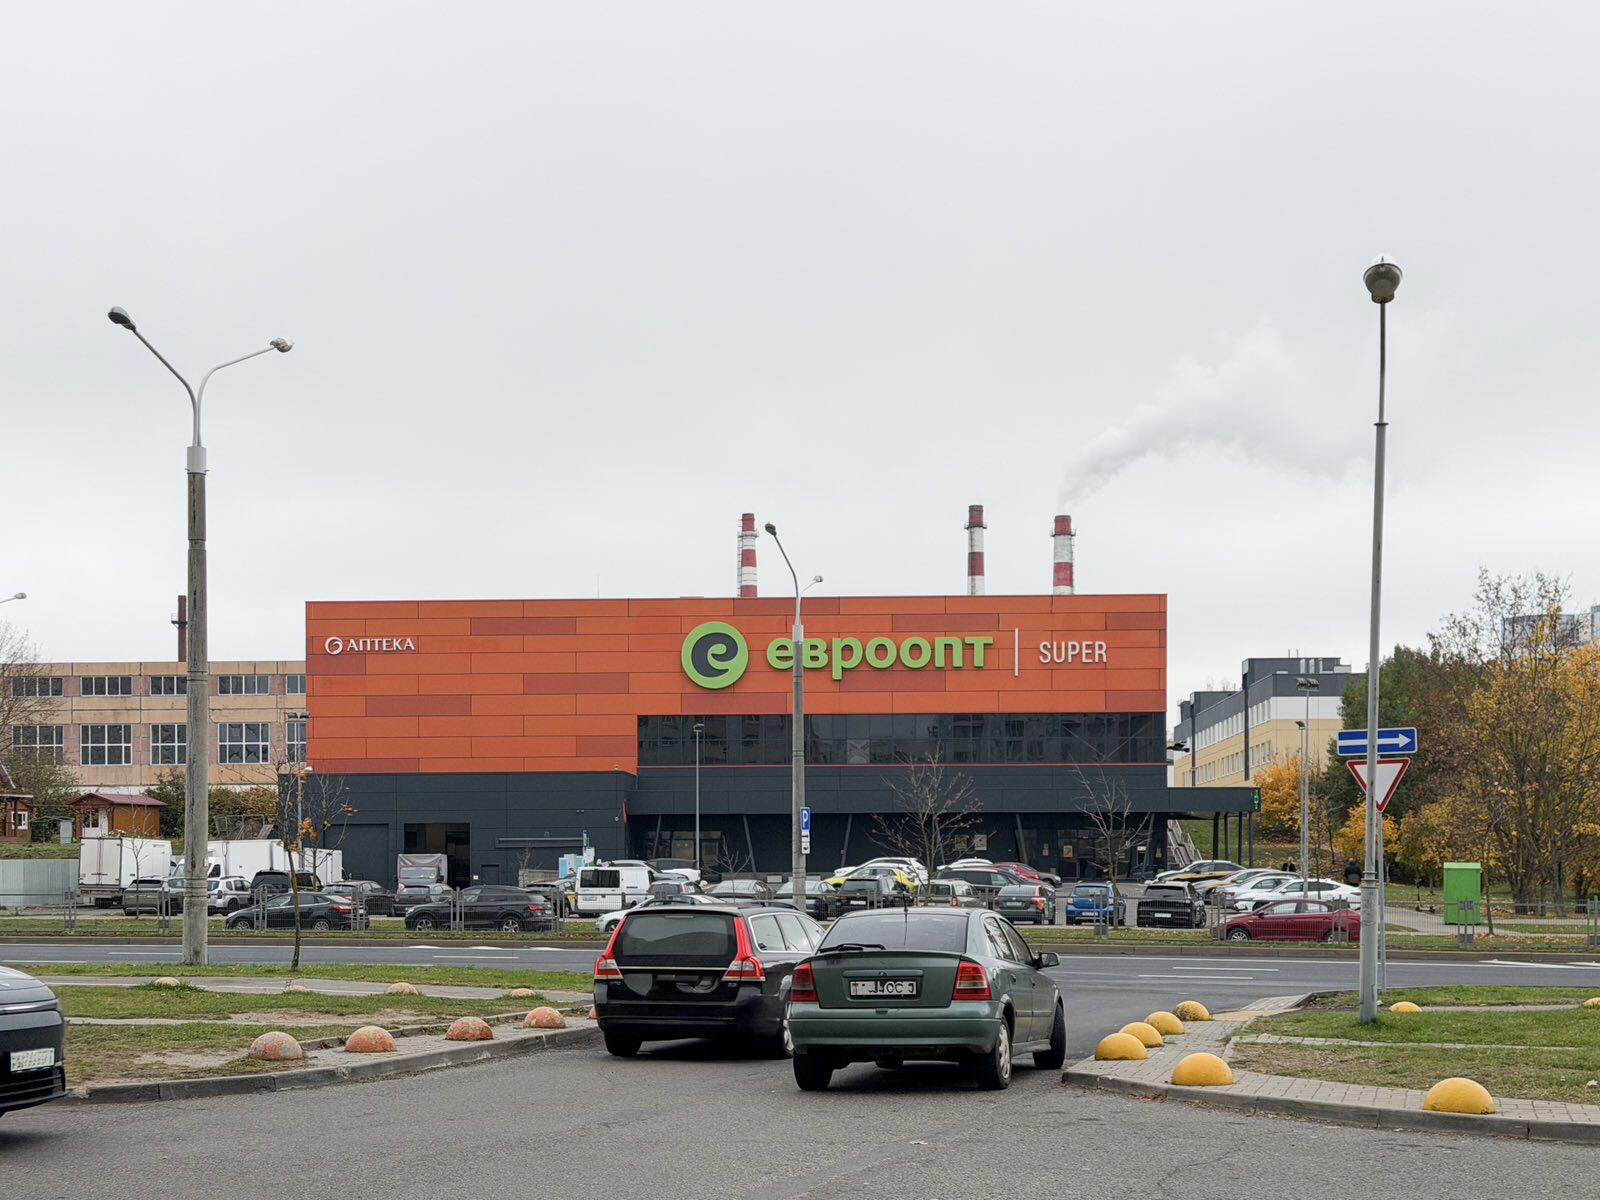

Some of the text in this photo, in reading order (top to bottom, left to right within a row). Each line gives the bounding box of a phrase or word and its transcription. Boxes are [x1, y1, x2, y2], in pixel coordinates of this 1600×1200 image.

[347, 637, 416, 652] АПТЕКА
[1039, 640, 1108, 664] SUPER
[766, 636, 994, 681] евроопт
[802, 810, 809, 829] P
